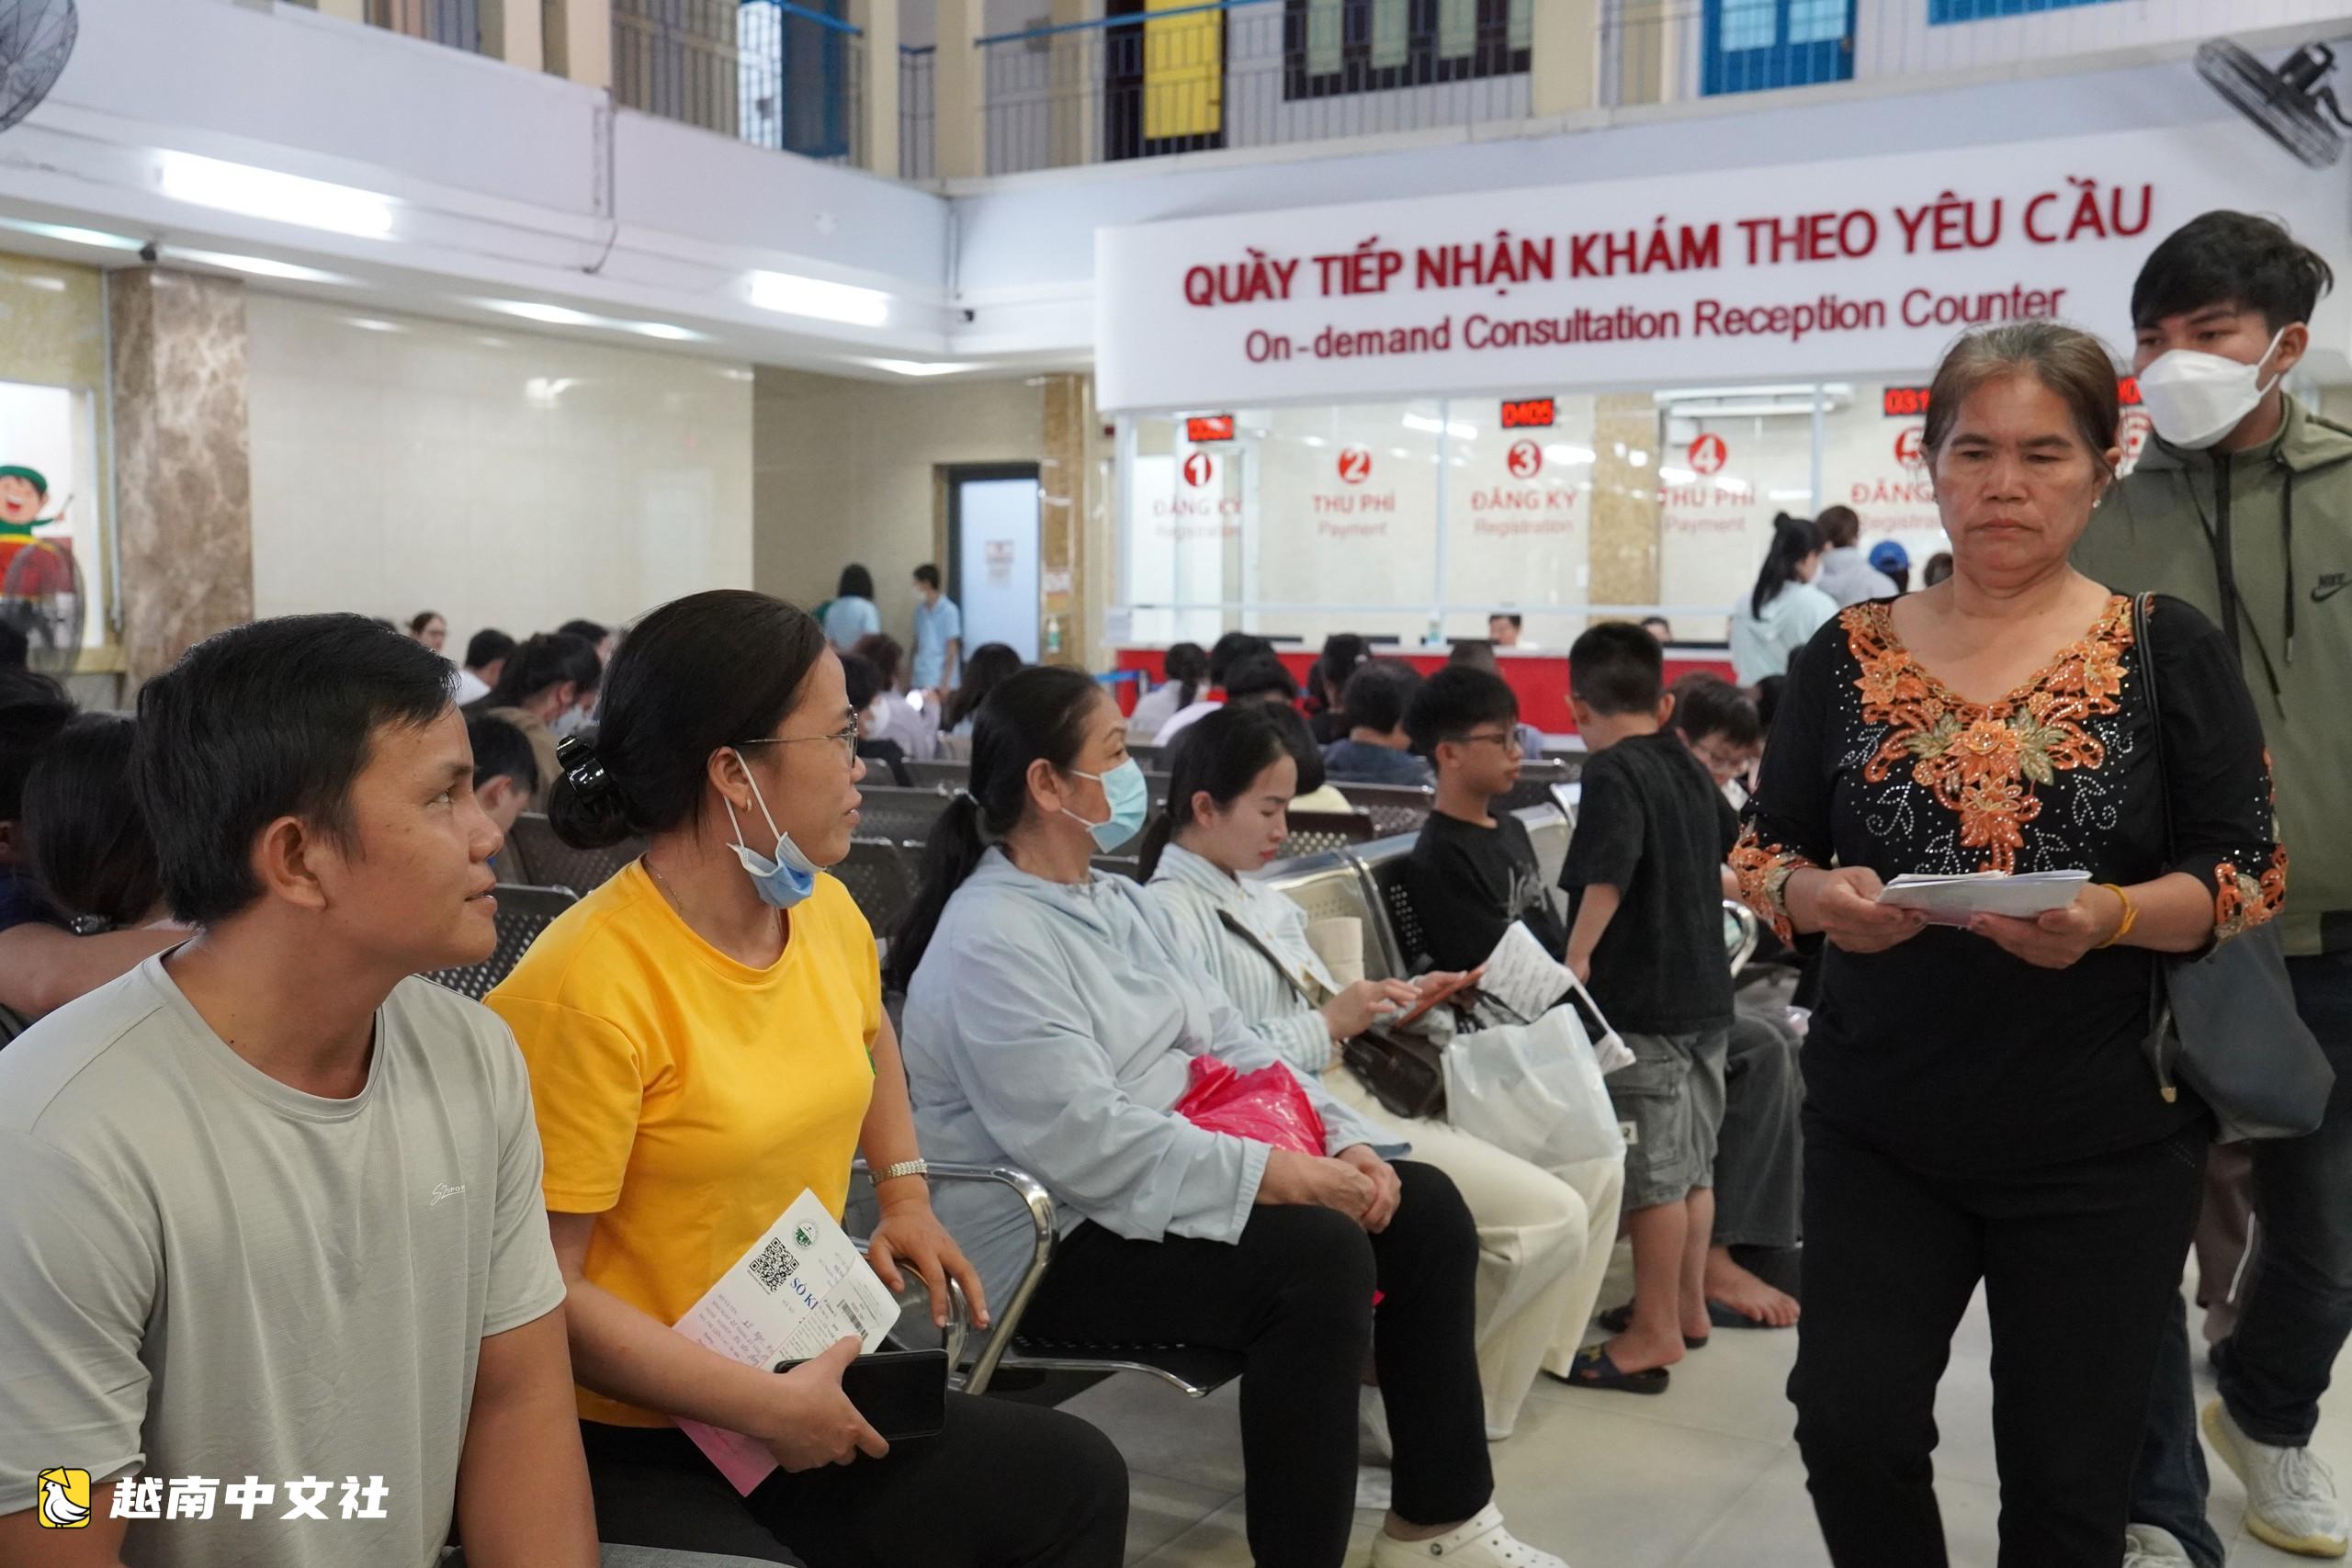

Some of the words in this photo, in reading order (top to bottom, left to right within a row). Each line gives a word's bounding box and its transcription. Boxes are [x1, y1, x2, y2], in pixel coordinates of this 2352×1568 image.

[1183, 246, 1300, 308] QUẦY
[1311, 233, 1404, 297] TIẾP
[1416, 229, 1555, 297] NHẬN
[1569, 214, 1721, 278] KHÁM
[1736, 209, 1879, 265] THEO
[1894, 190, 2004, 254] YÊU
[2023, 175, 2153, 244] CẦU
[1245, 316, 1451, 362] On-demand
[1464, 306, 1680, 350] Consultation
[1693, 294, 1886, 343] Reception
[1901, 282, 2066, 327] Counter
[1188, 453, 1207, 487] 1
[1343, 448, 1369, 481] 2
[1511, 441, 1537, 478] 3
[1690, 435, 1723, 473] 4
[1312, 493, 1355, 514] THU
